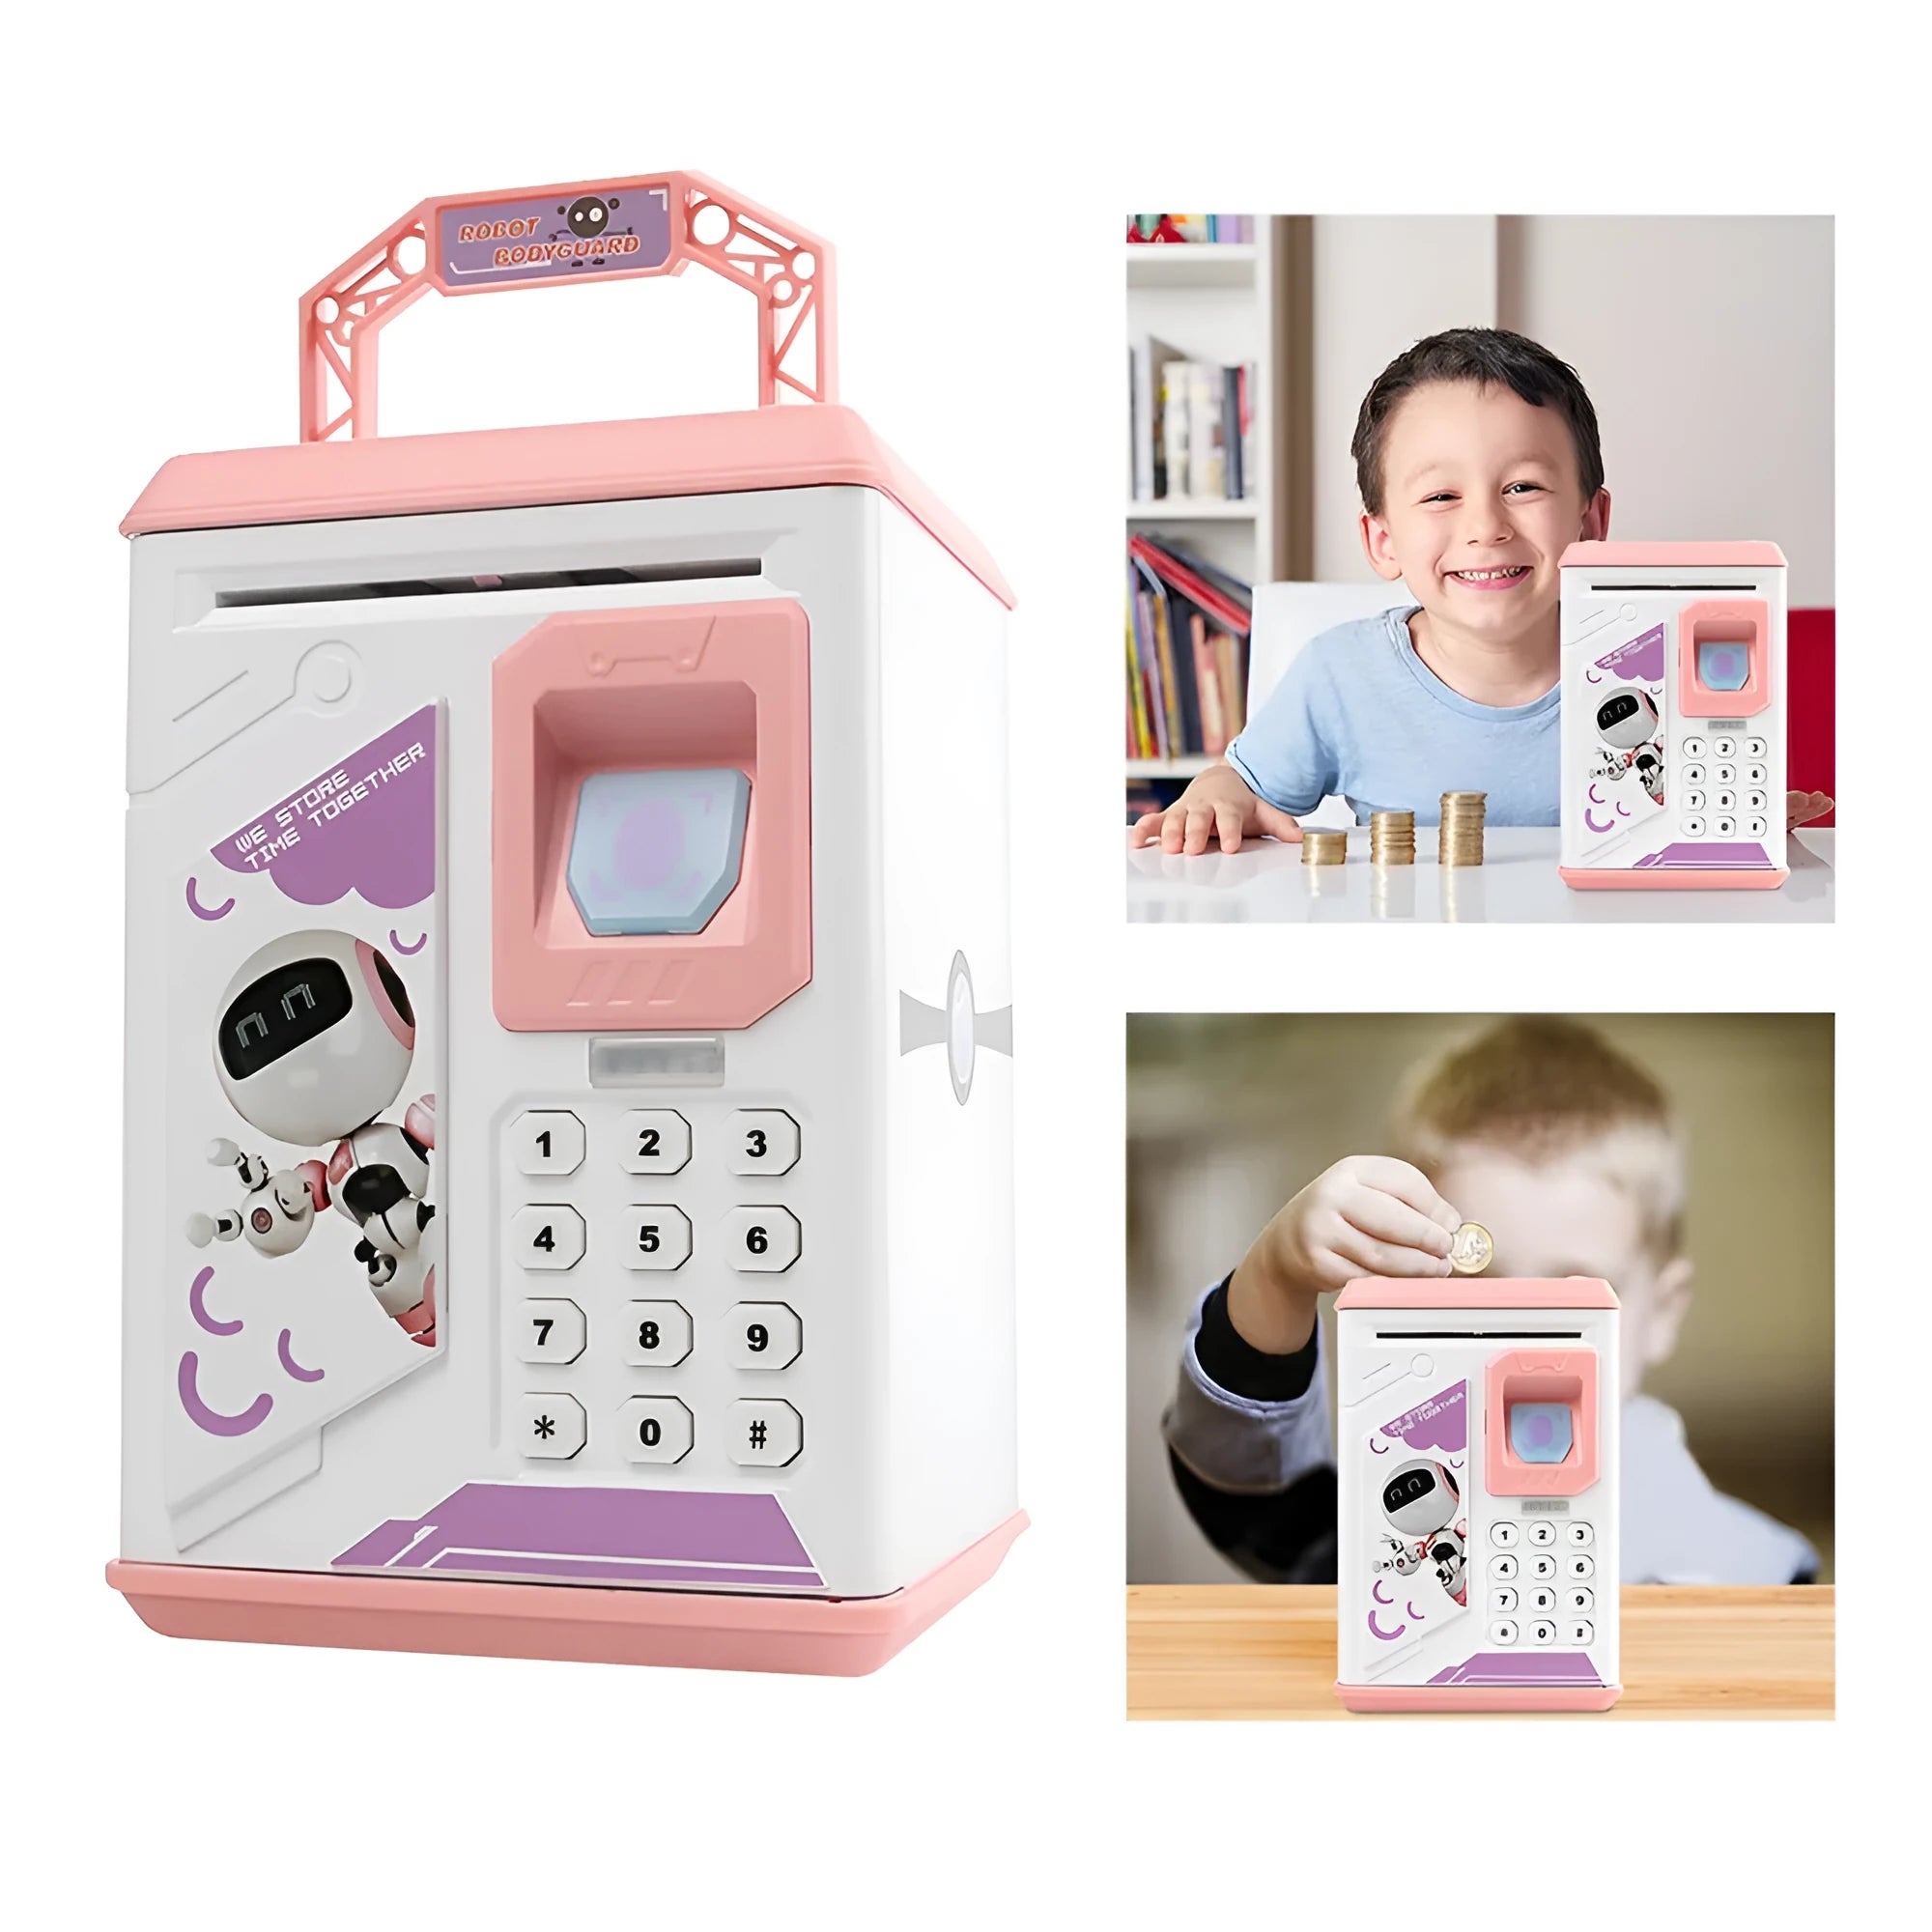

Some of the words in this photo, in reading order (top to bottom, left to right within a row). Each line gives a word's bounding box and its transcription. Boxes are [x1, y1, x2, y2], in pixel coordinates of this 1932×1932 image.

[458, 216, 540, 243] ROBOT
[494, 235, 640, 268] BODYGUARD
[235, 824, 268, 853] WE
[274, 769, 350, 828] STORE
[244, 827, 301, 869] TIME
[307, 742, 426, 827] TOGETHER
[535, 1130, 552, 1158] 1
[638, 1128, 661, 1156] 2
[745, 1129, 767, 1158] 3
[532, 1225, 555, 1253] 4
[639, 1225, 660, 1253] 5
[746, 1226, 768, 1255] 6
[532, 1319, 554, 1347] 7
[639, 1321, 660, 1350] 8
[746, 1323, 769, 1352] 9
[639, 1418, 662, 1447] 0
[749, 1420, 768, 1450] #
